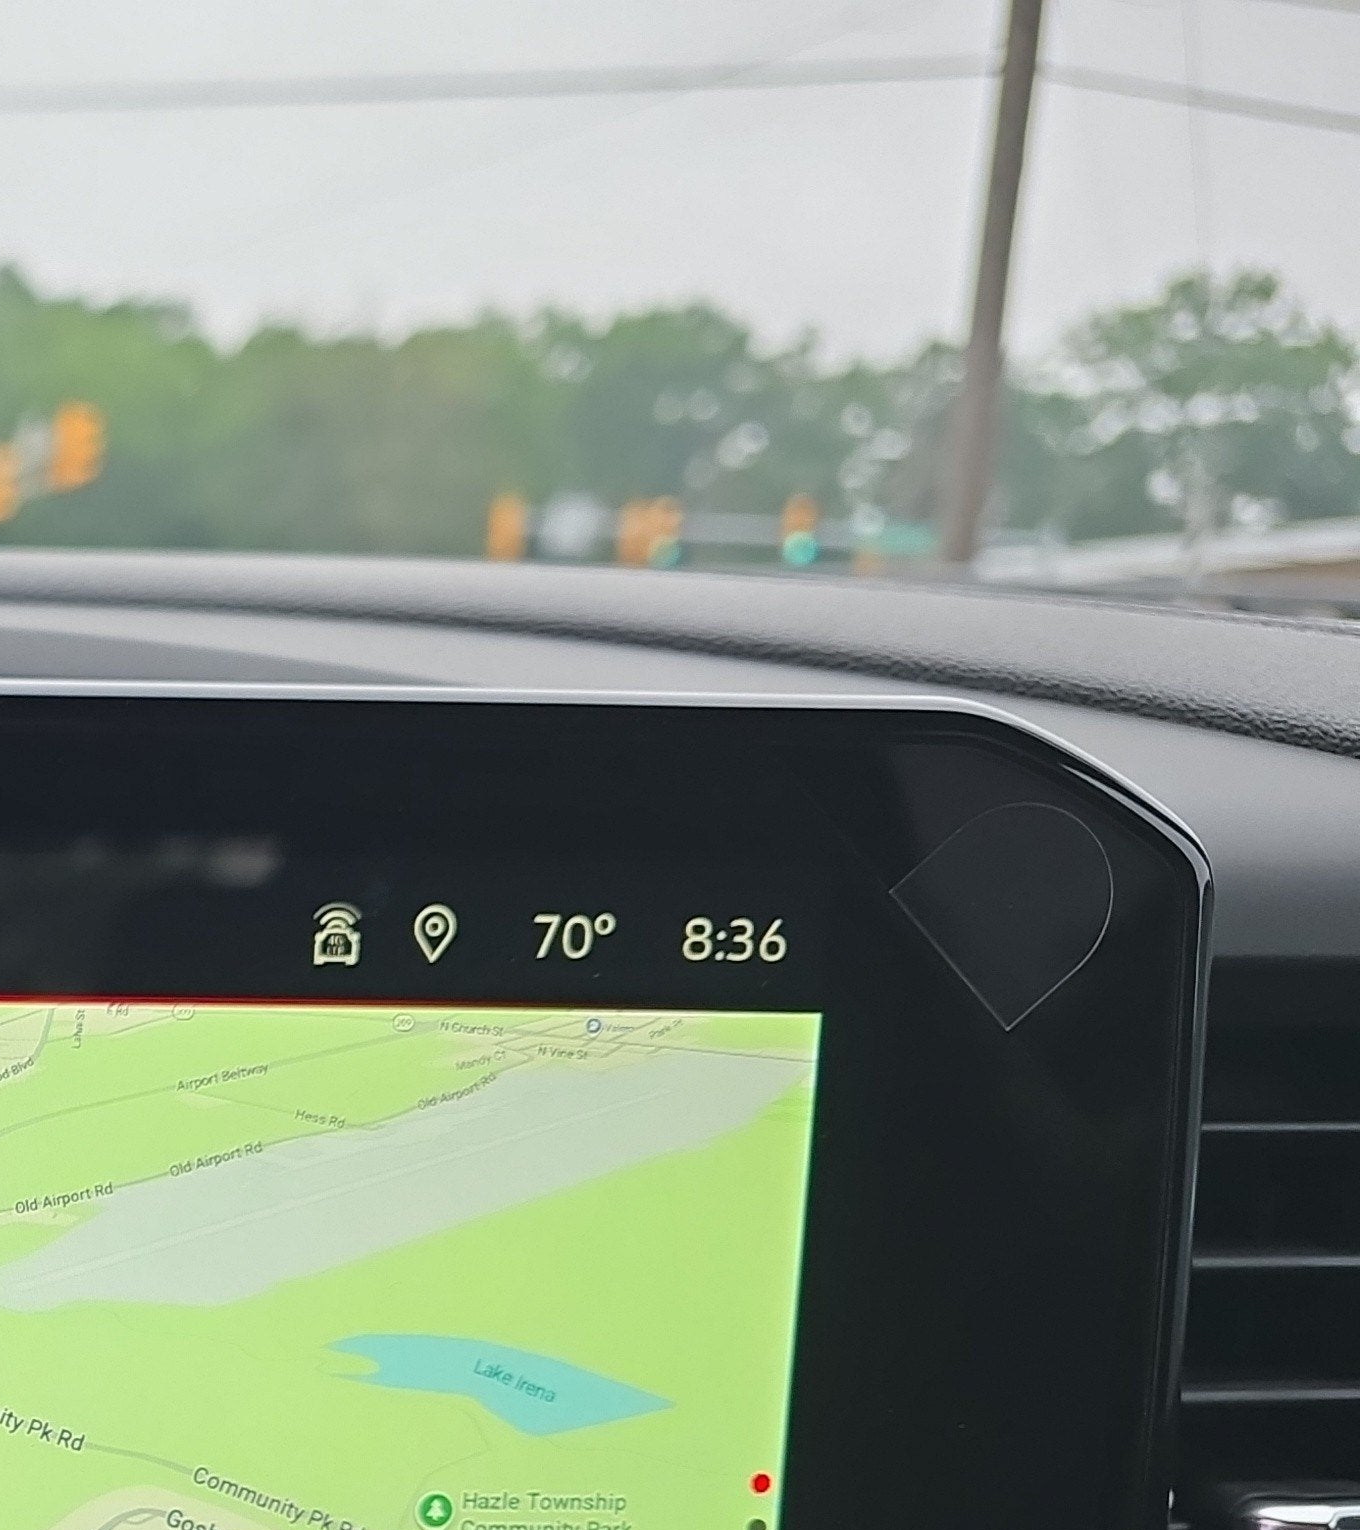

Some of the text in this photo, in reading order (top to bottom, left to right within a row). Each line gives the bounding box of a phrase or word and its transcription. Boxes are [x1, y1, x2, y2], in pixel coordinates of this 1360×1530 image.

[682, 916, 788, 963] 8:36
[452, 1021, 490, 1036] Church
[11, 1057, 34, 1075] Blvd
[177, 1063, 269, 1092] Airport Beltway
[440, 1083, 479, 1104] Airport
[480, 1072, 497, 1087] Rd
[294, 1108, 346, 1129] Hess Rd
[169, 1141, 264, 1177] Old Airport Rd
[14, 1182, 114, 1214] Old Airport Rd
[473, 1358, 557, 1403] Lake Irena
[26, 1418, 53, 1442] Pk
[57, 1429, 85, 1452] Rd
[193, 1466, 305, 1525] Community
[461, 1491, 627, 1515] Hazle Township
